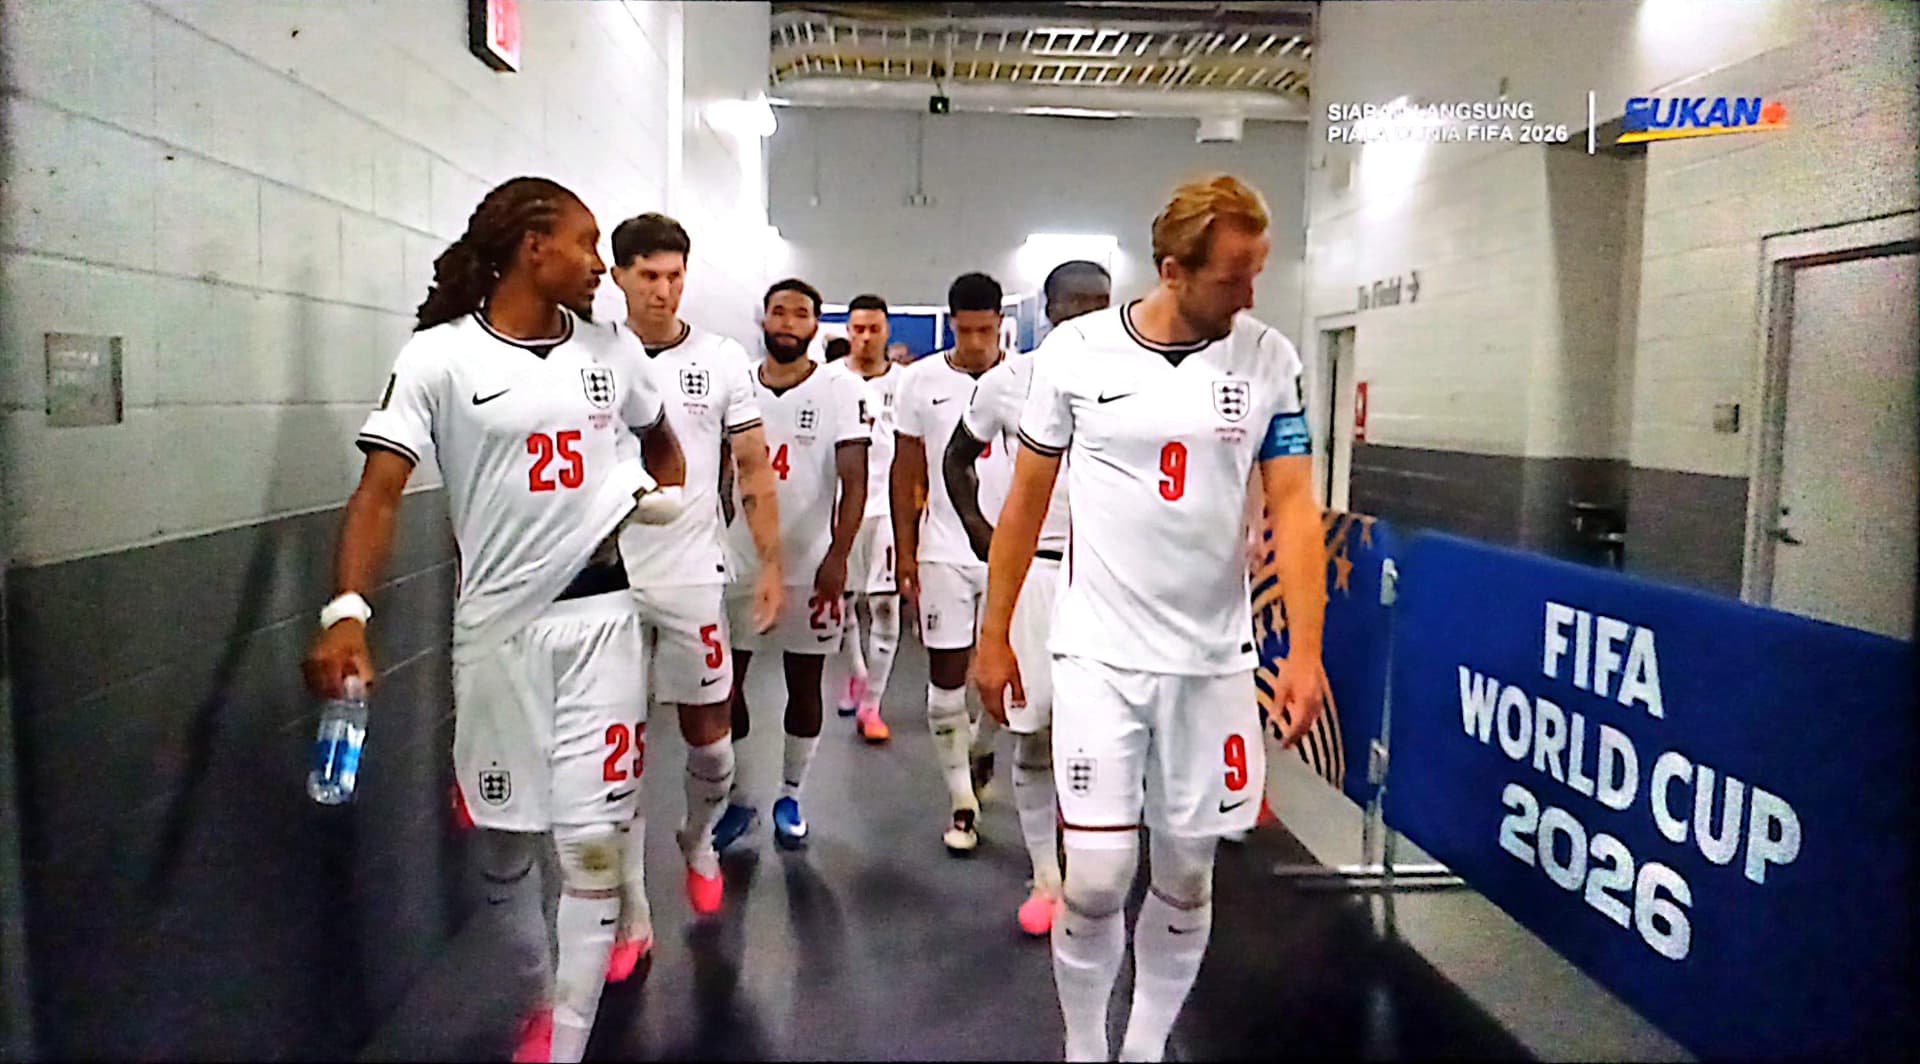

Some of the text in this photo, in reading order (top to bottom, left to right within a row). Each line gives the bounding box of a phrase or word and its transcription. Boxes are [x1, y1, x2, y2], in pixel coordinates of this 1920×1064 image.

[526, 430, 584, 491] 25
[764, 444, 790, 480] 4
[1159, 441, 1187, 501] 9
[700, 624, 723, 669] 5
[1543, 601, 1665, 719] FIFA
[1224, 734, 1247, 791] 9
[1458, 665, 1801, 885] WORLD CUP
[1500, 783, 1693, 961] 2026
